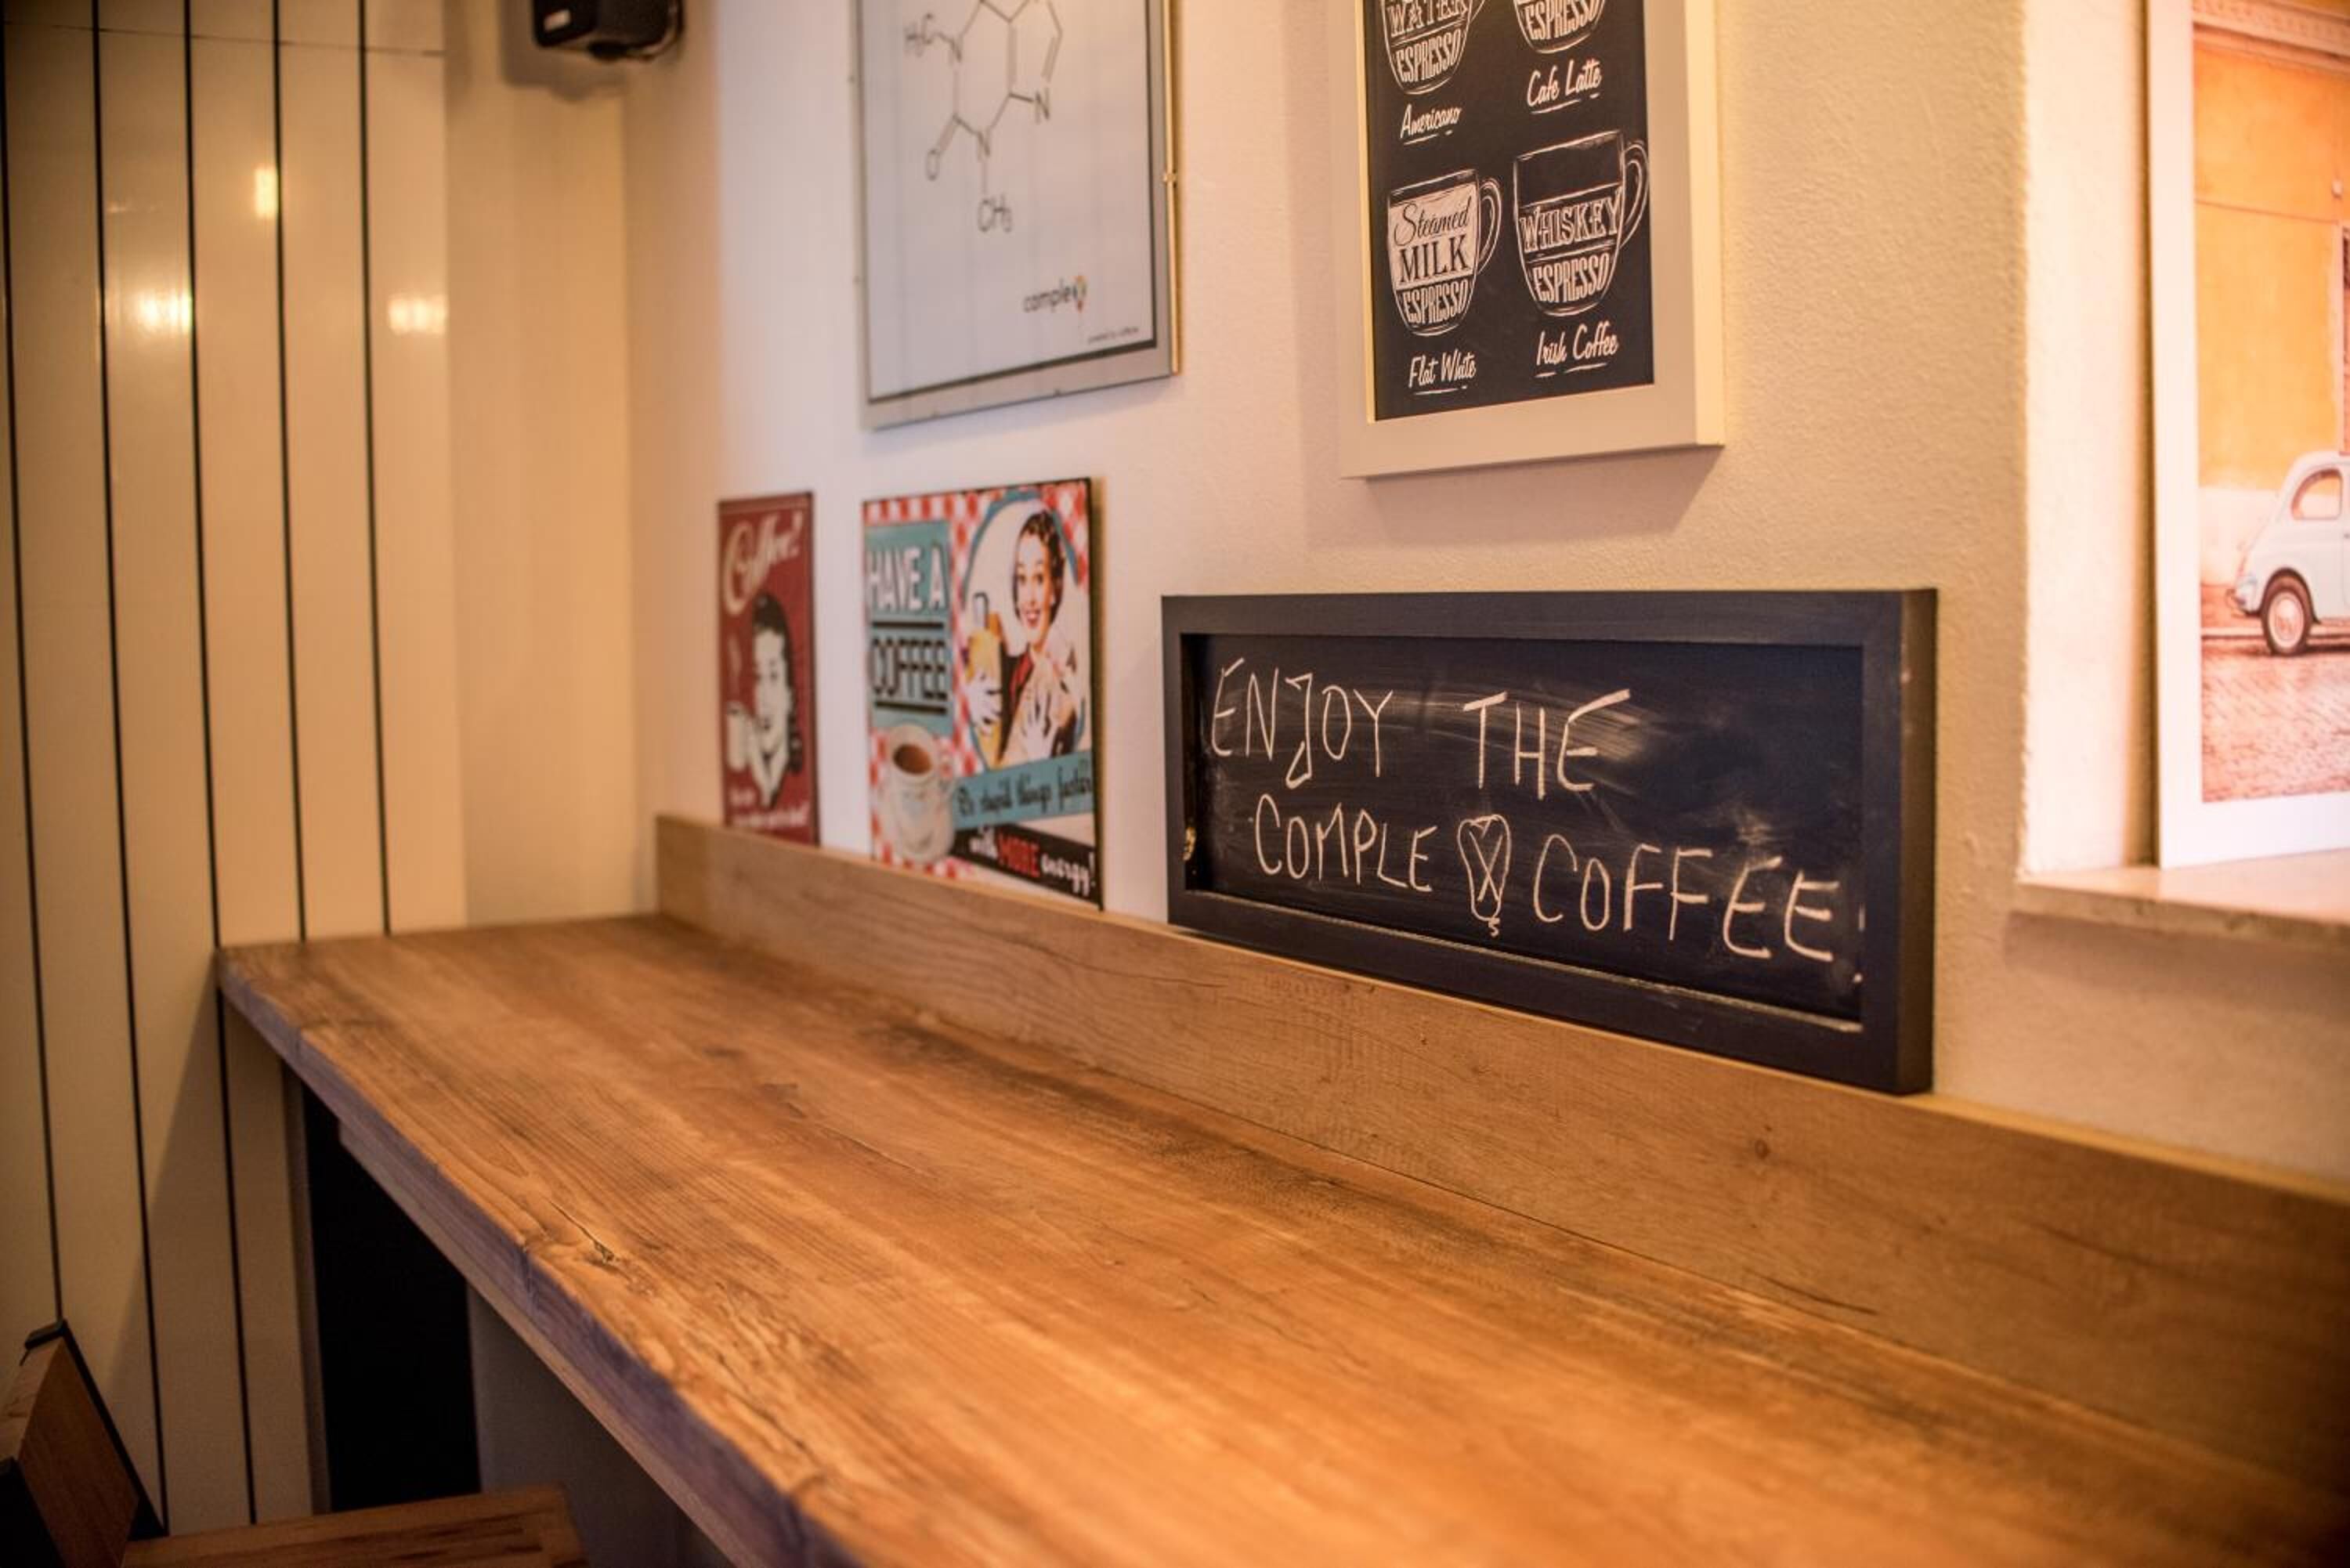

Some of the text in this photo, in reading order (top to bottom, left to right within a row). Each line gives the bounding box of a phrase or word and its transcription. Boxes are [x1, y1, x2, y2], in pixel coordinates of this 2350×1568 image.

[1395, 28, 1462, 82] ESPRESSO
[1565, 59, 1603, 94] Latte
[1400, 103, 1462, 139] Americano
[1394, 194, 1472, 246] Steamed
[1520, 189, 1622, 251] WHISKEY
[1399, 233, 1470, 284] MILK
[1533, 252, 1611, 303] ESPRESSO
[1402, 279, 1470, 324] ESPRESSO
[1408, 349, 1476, 388] Flat White
[1536, 320, 1620, 367] Irish Coffee
[864, 540, 949, 612] HAVE A
[868, 635, 947, 702] COFFEE
[1210, 656, 1631, 800] ENJOY THE
